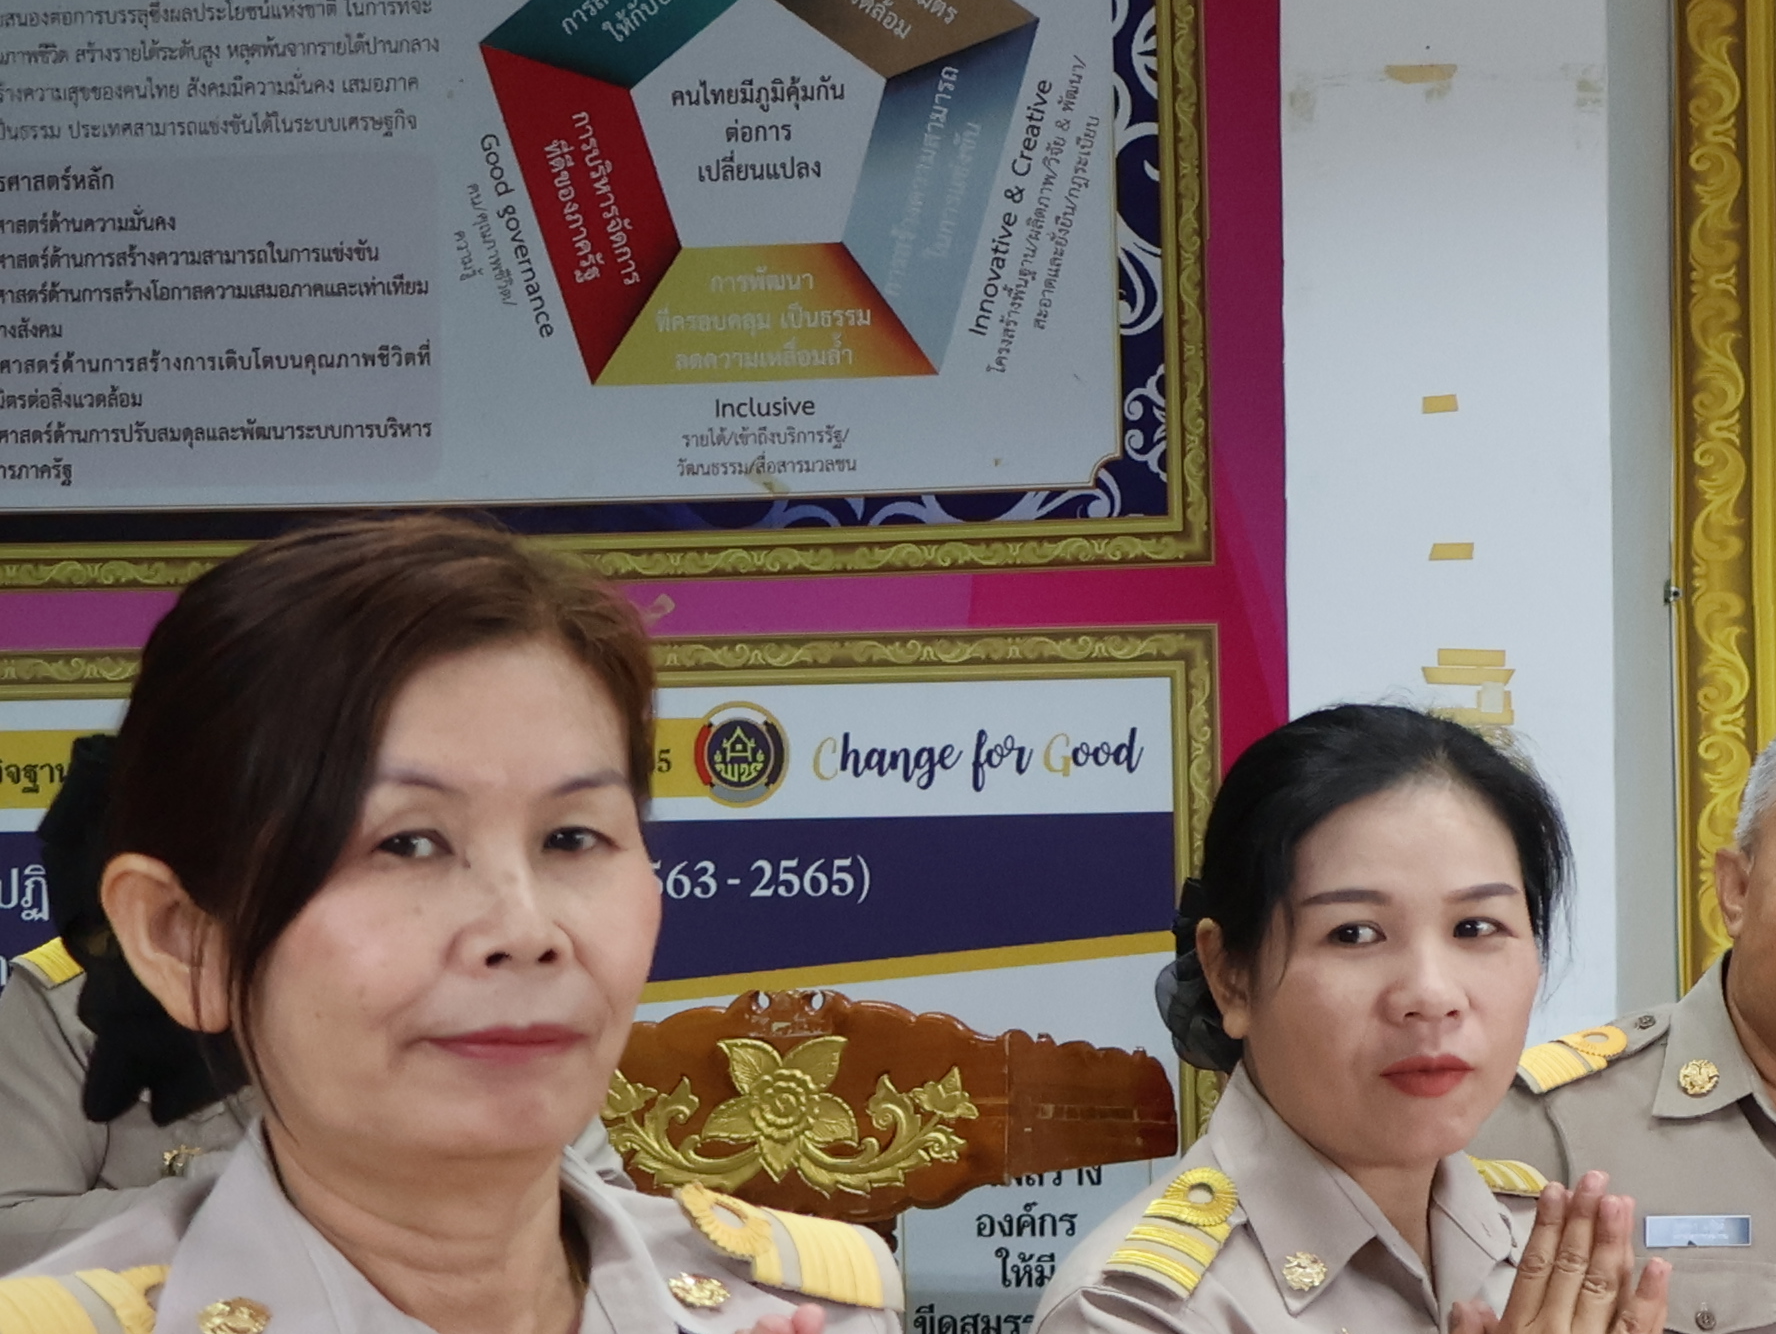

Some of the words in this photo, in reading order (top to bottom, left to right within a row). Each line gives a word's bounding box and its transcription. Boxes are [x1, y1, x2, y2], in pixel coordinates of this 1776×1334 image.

[186, 67, 335, 99] สังคมมีความมั่นคง
[341, 75, 419, 95] เสมอภาค
[671, 75, 846, 114] คนไทยมีภูมิคุ้มกัน
[725, 119, 793, 145] ต่อการ
[480, 133, 514, 199] Good
[698, 150, 823, 184] เปลี่ยนแปลง
[543, 138, 602, 284] ที่ดีของภาครัฐ
[571, 111, 641, 288] การบริหารจัดการ
[967, 212, 1019, 339] Innovative
[1003, 186, 1027, 205] &
[1018, 78, 1054, 179] Creative
[496, 203, 556, 340] governance
[711, 266, 814, 294] การพัฒนา
[780, 303, 872, 331] เป็นธรรม
[714, 395, 816, 420] Inclusive
[813, 731, 964, 790] Change
[970, 729, 1034, 793] for
[1042, 726, 1145, 778] Good
[749, 853, 872, 905] 2565)
[975, 1203, 1078, 1239] องค์กร
